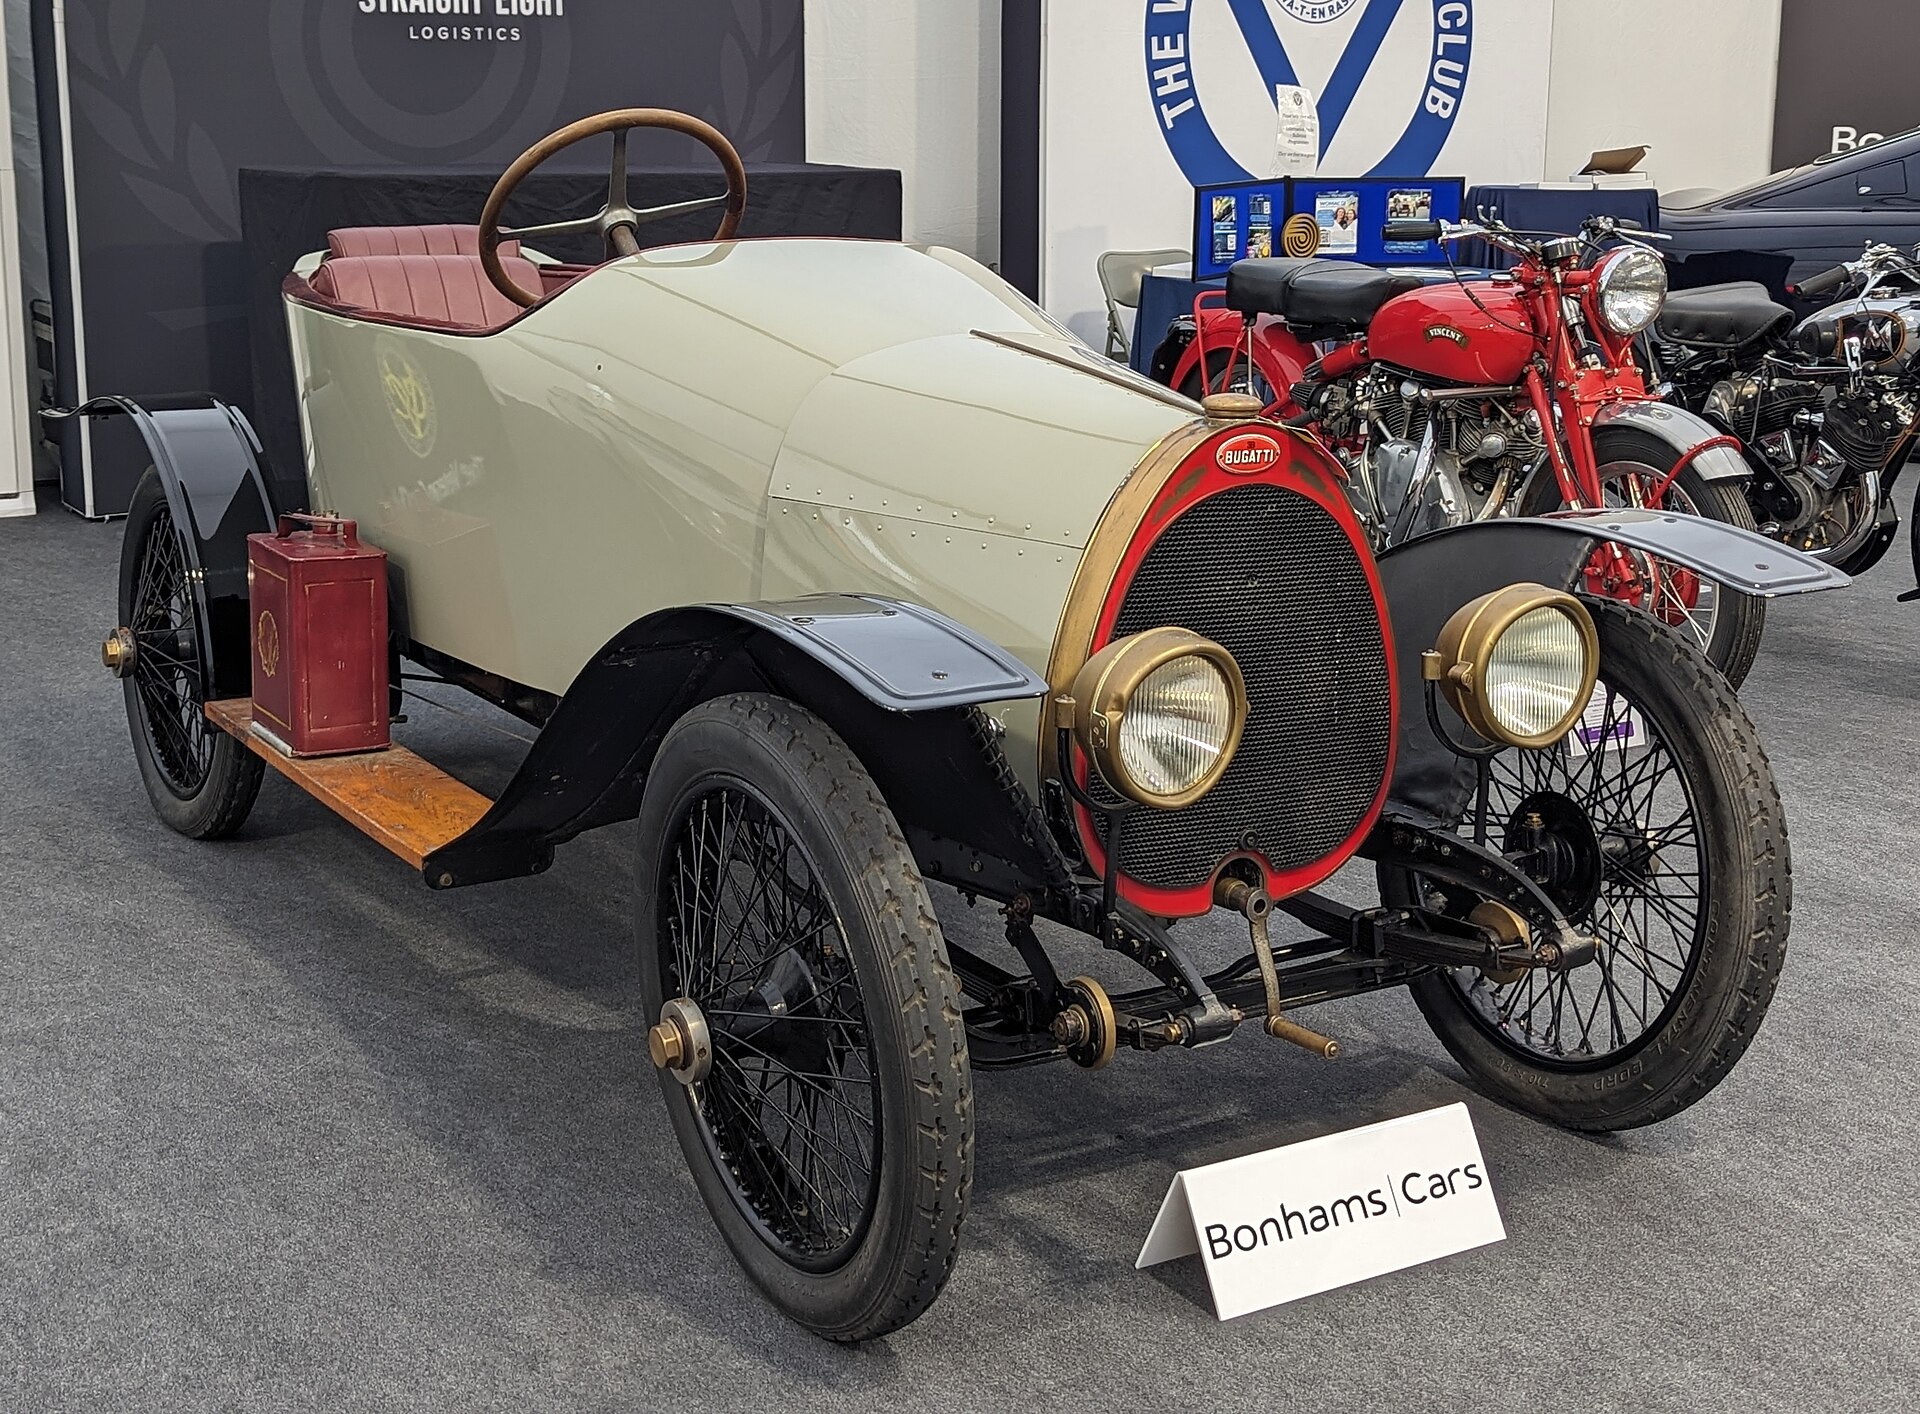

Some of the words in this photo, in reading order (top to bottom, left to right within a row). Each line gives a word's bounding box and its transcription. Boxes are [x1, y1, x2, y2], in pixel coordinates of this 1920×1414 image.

[1282, 0, 1326, 19] A-T-EN
[408, 26, 521, 41] LOGISTICS
[1424, 2, 1468, 119] CLUB
[1150, 33, 1196, 130] THE
[1429, 327, 1462, 341] VINCENT
[1225, 449, 1274, 464] BUGATTI
[1205, 1188, 1388, 1260] Bonhams
[1401, 1163, 1483, 1205] Cars
